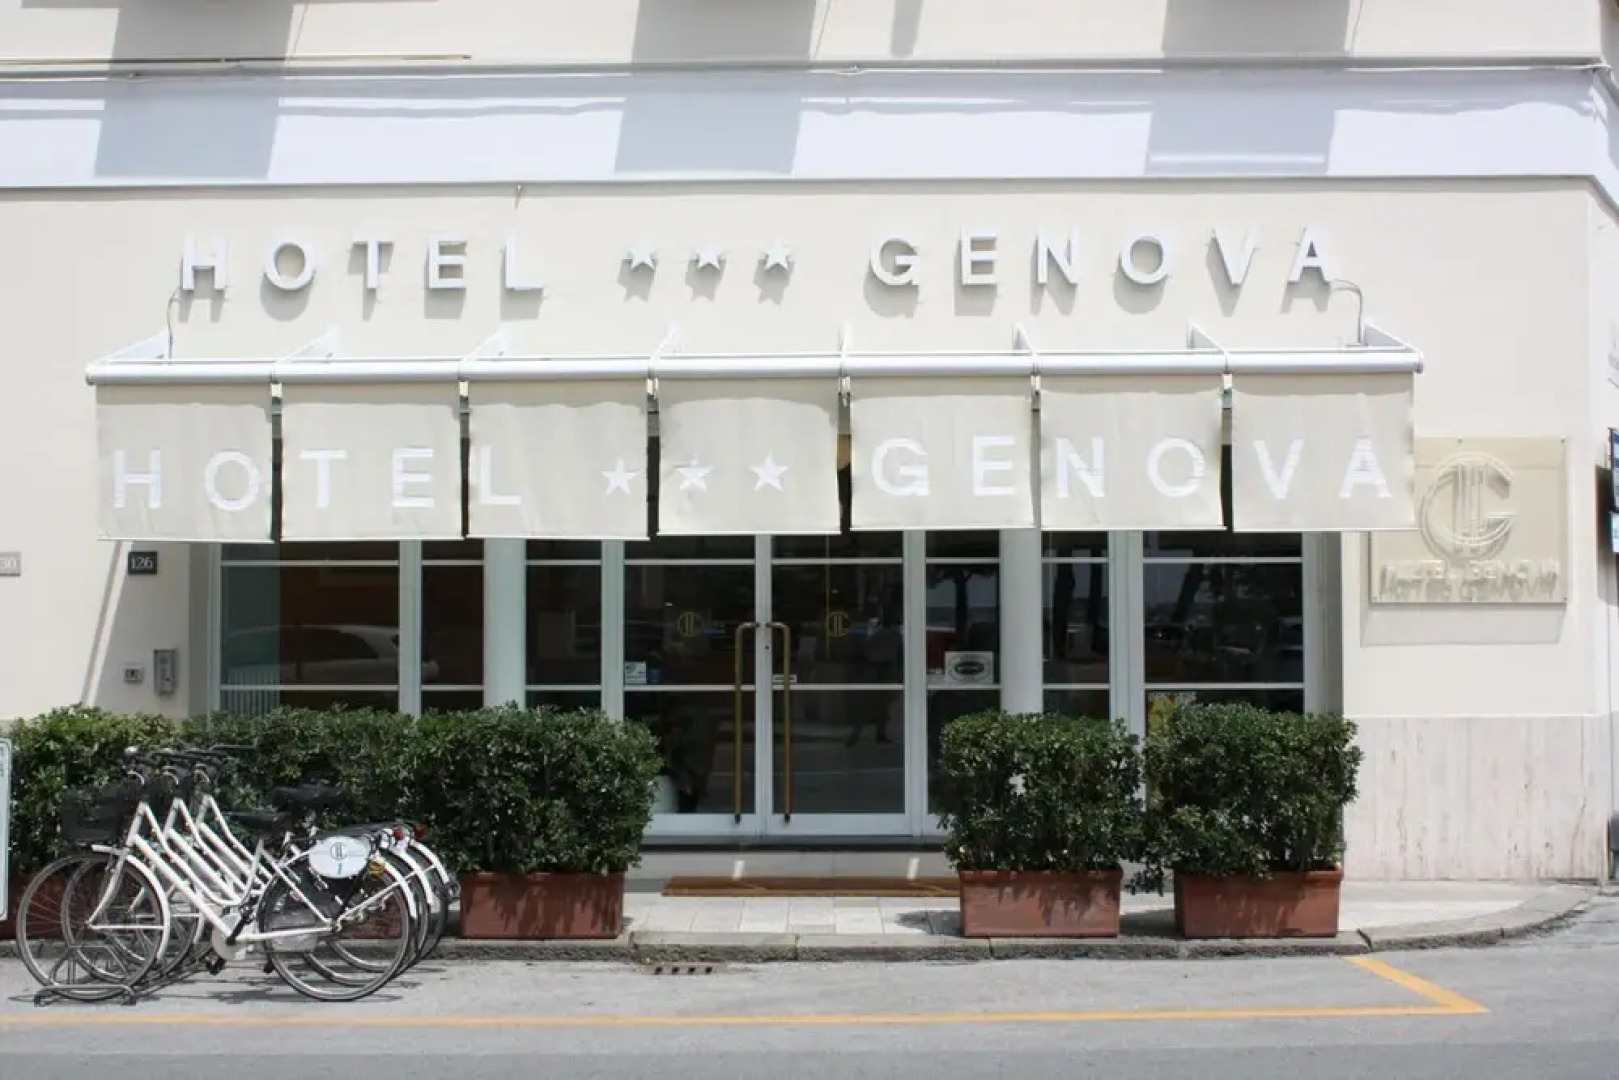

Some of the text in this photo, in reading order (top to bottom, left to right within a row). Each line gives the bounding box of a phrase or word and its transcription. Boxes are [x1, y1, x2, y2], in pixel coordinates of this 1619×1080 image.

[182, 227, 1331, 291] HOTEL GENOVA
[113, 434, 1394, 512] HOTEL GENOVA
[130, 556, 154, 571] 126
